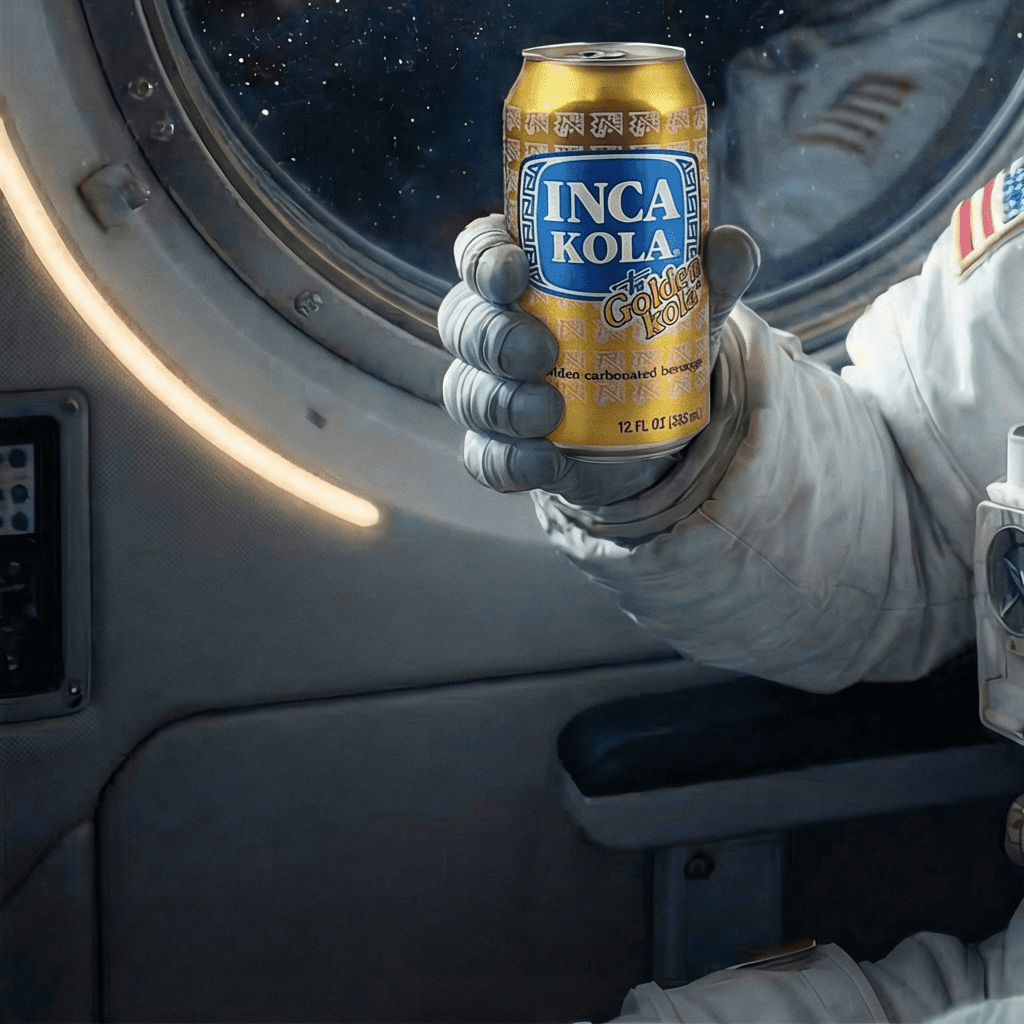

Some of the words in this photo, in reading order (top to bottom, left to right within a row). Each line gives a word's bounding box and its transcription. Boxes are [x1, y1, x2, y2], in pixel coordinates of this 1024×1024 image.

[543, 179, 681, 224] INCA
[550, 229, 676, 265] KOLA
[603, 257, 700, 328] Golden
[618, 420, 633, 433] 12
[635, 419, 649, 432] FL
